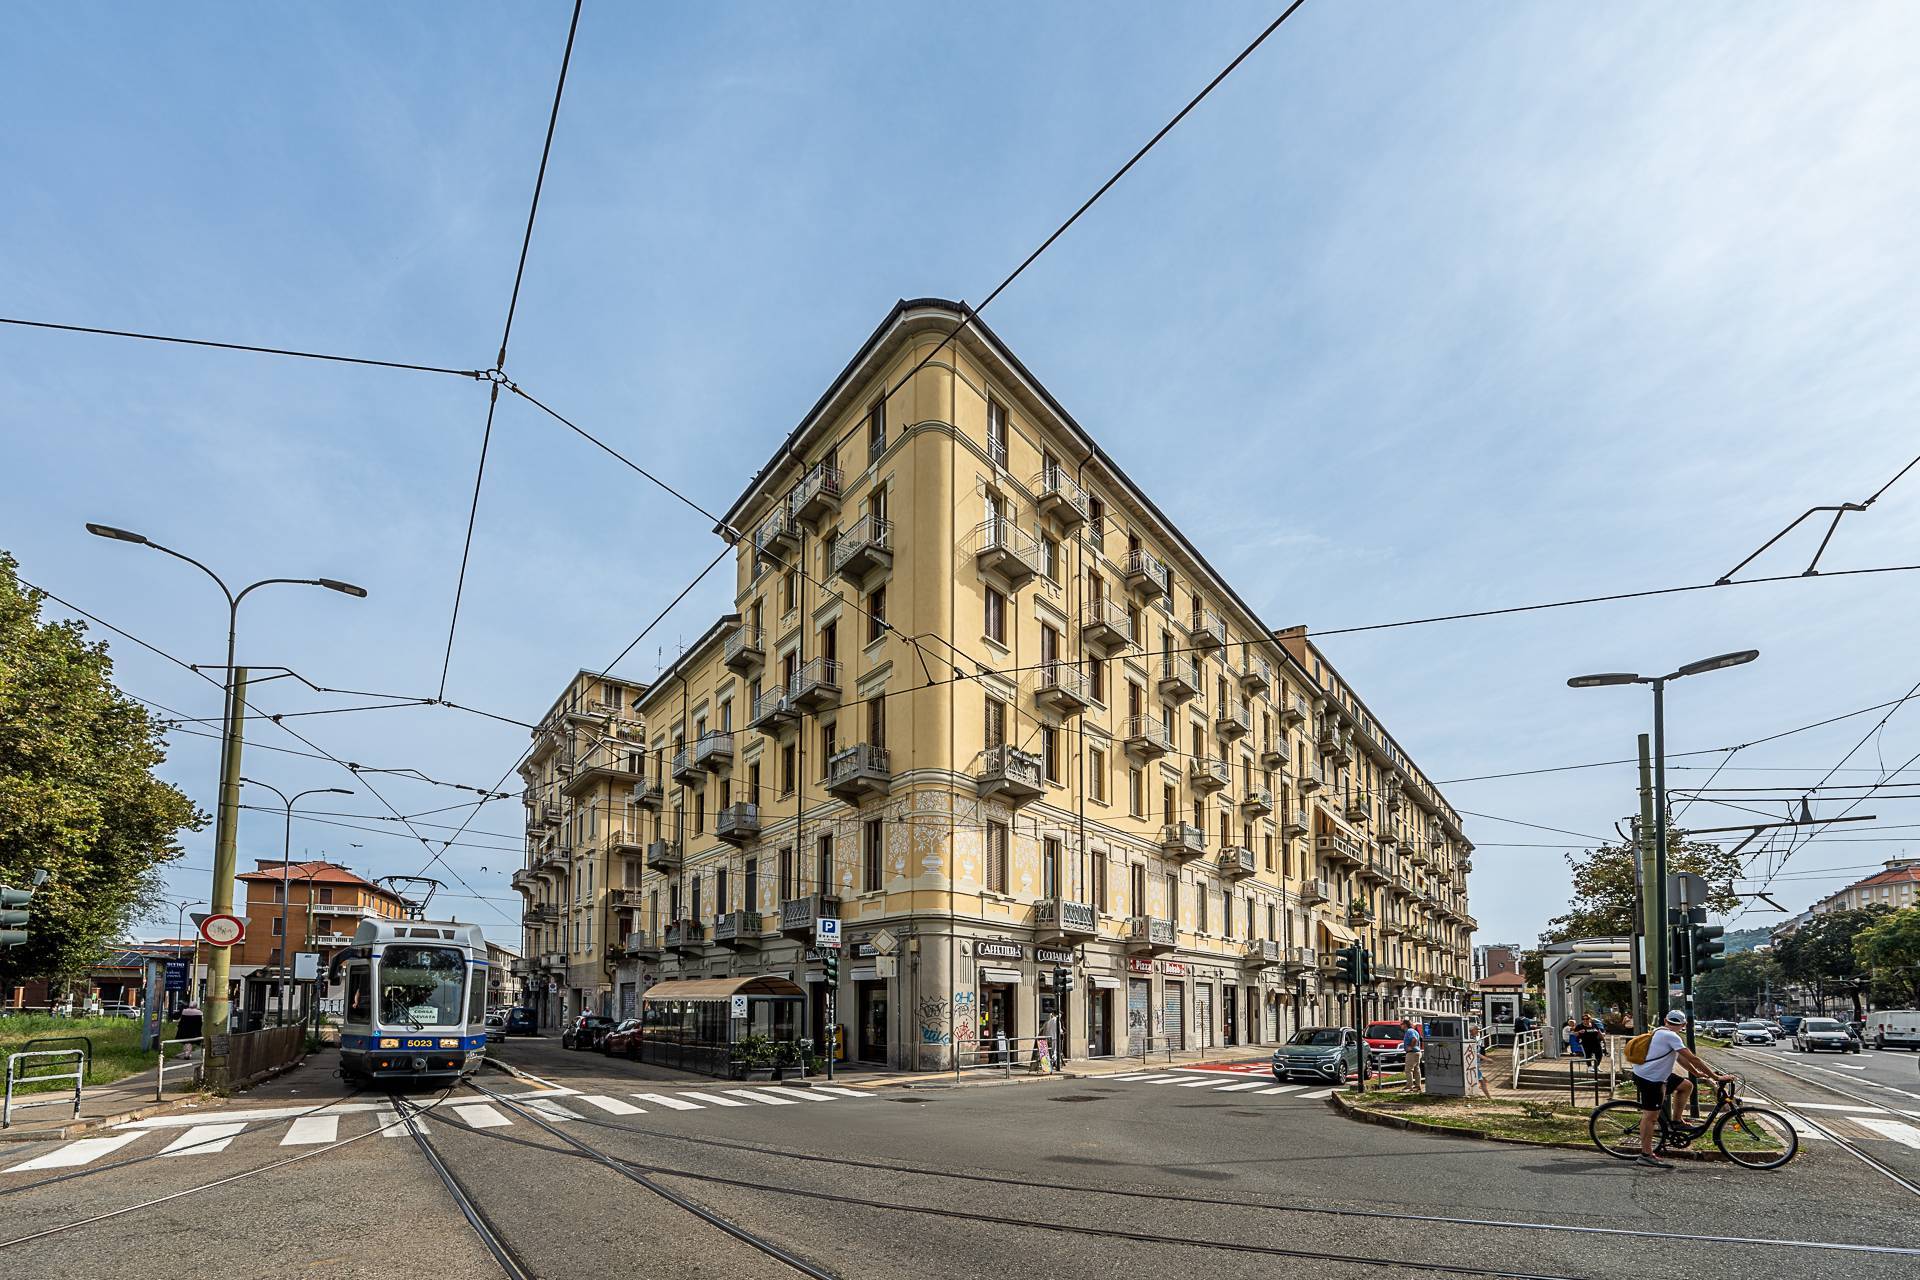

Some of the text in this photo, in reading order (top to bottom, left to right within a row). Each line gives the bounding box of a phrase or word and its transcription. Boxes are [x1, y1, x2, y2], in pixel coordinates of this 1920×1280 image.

[825, 922, 833, 931] P
[1136, 960, 1151, 971] Pizza
[407, 1039, 433, 1048] 5023
